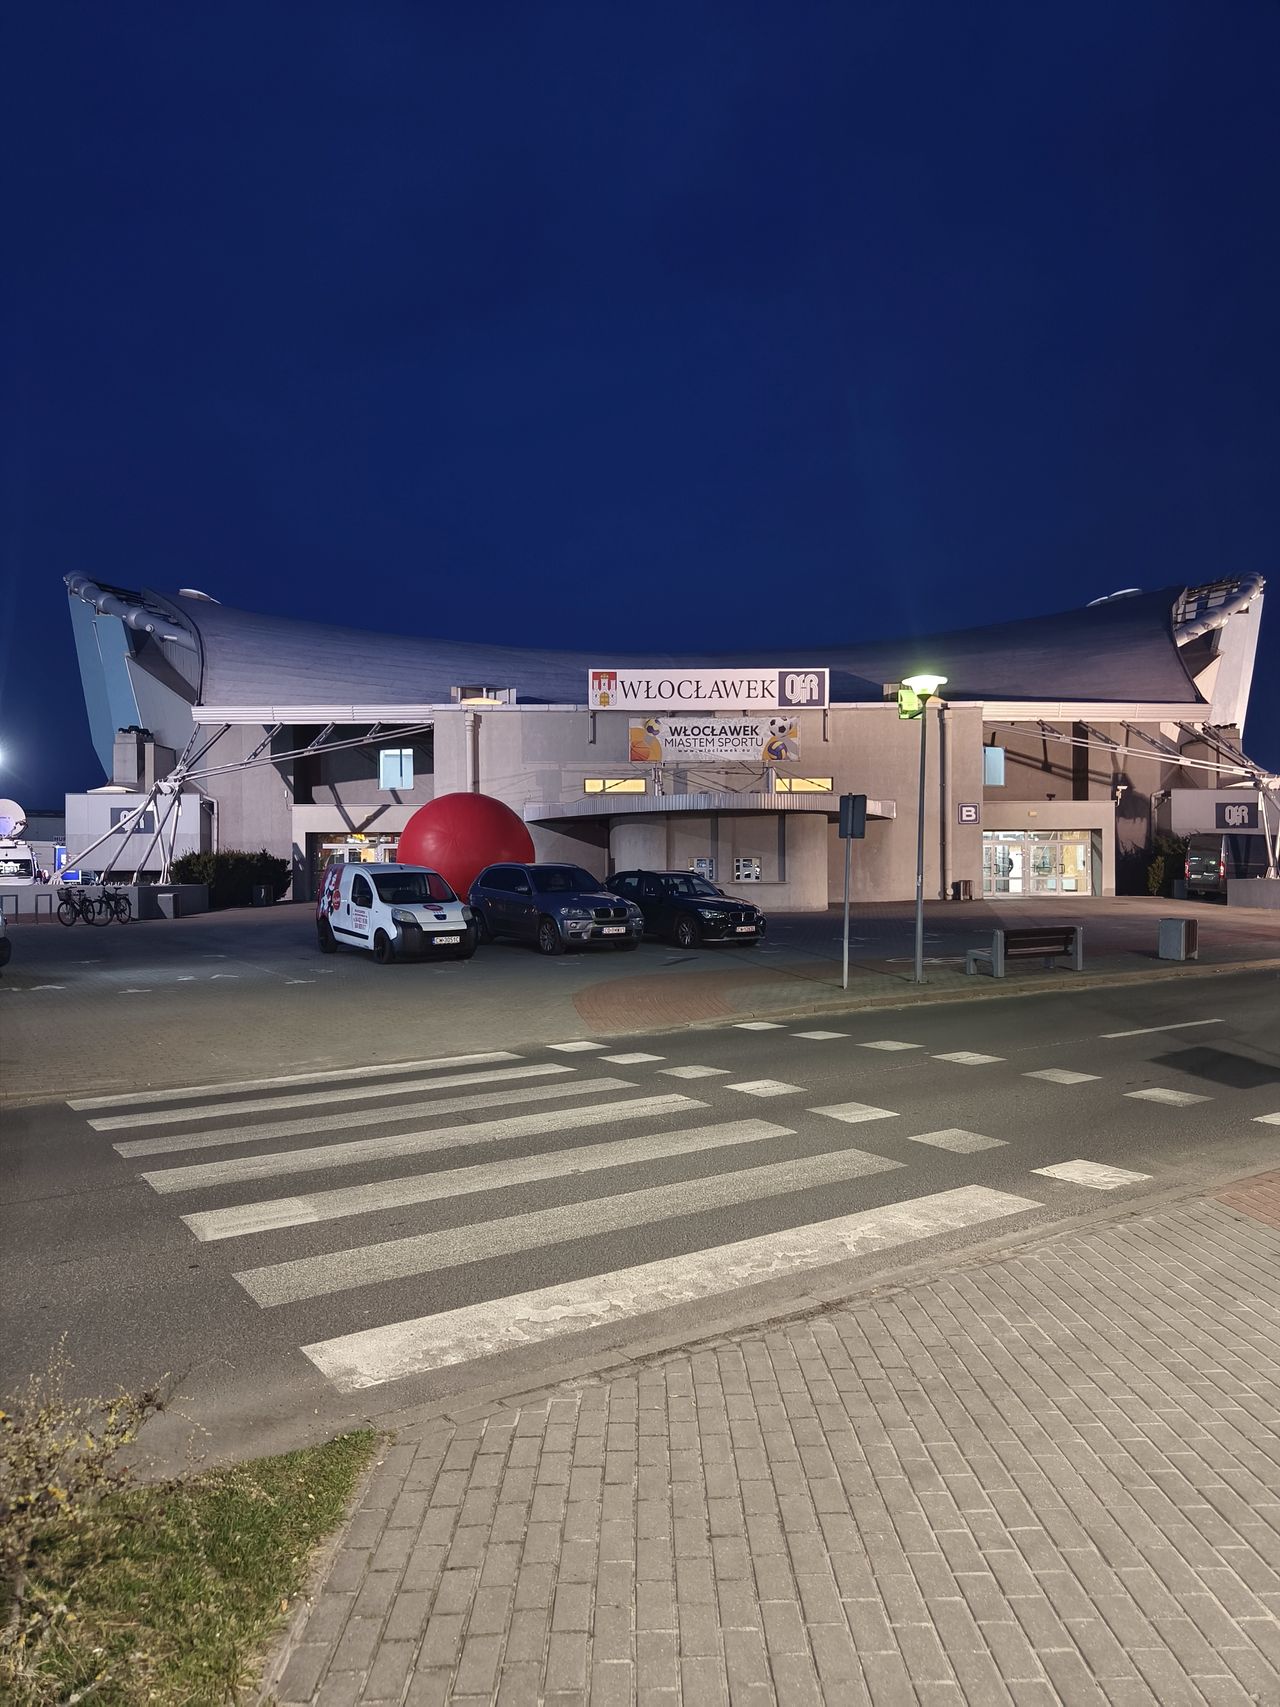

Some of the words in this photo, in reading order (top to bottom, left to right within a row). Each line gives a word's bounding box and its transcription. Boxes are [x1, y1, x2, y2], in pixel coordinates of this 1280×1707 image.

[620, 679, 776, 699] WŁOCŁAWEK
[669, 725, 759, 737] WŁOCŁAWEK
[664, 737, 715, 747] MIASTEM
[717, 737, 764, 747] SPORTU
[961, 807, 976, 820] B
